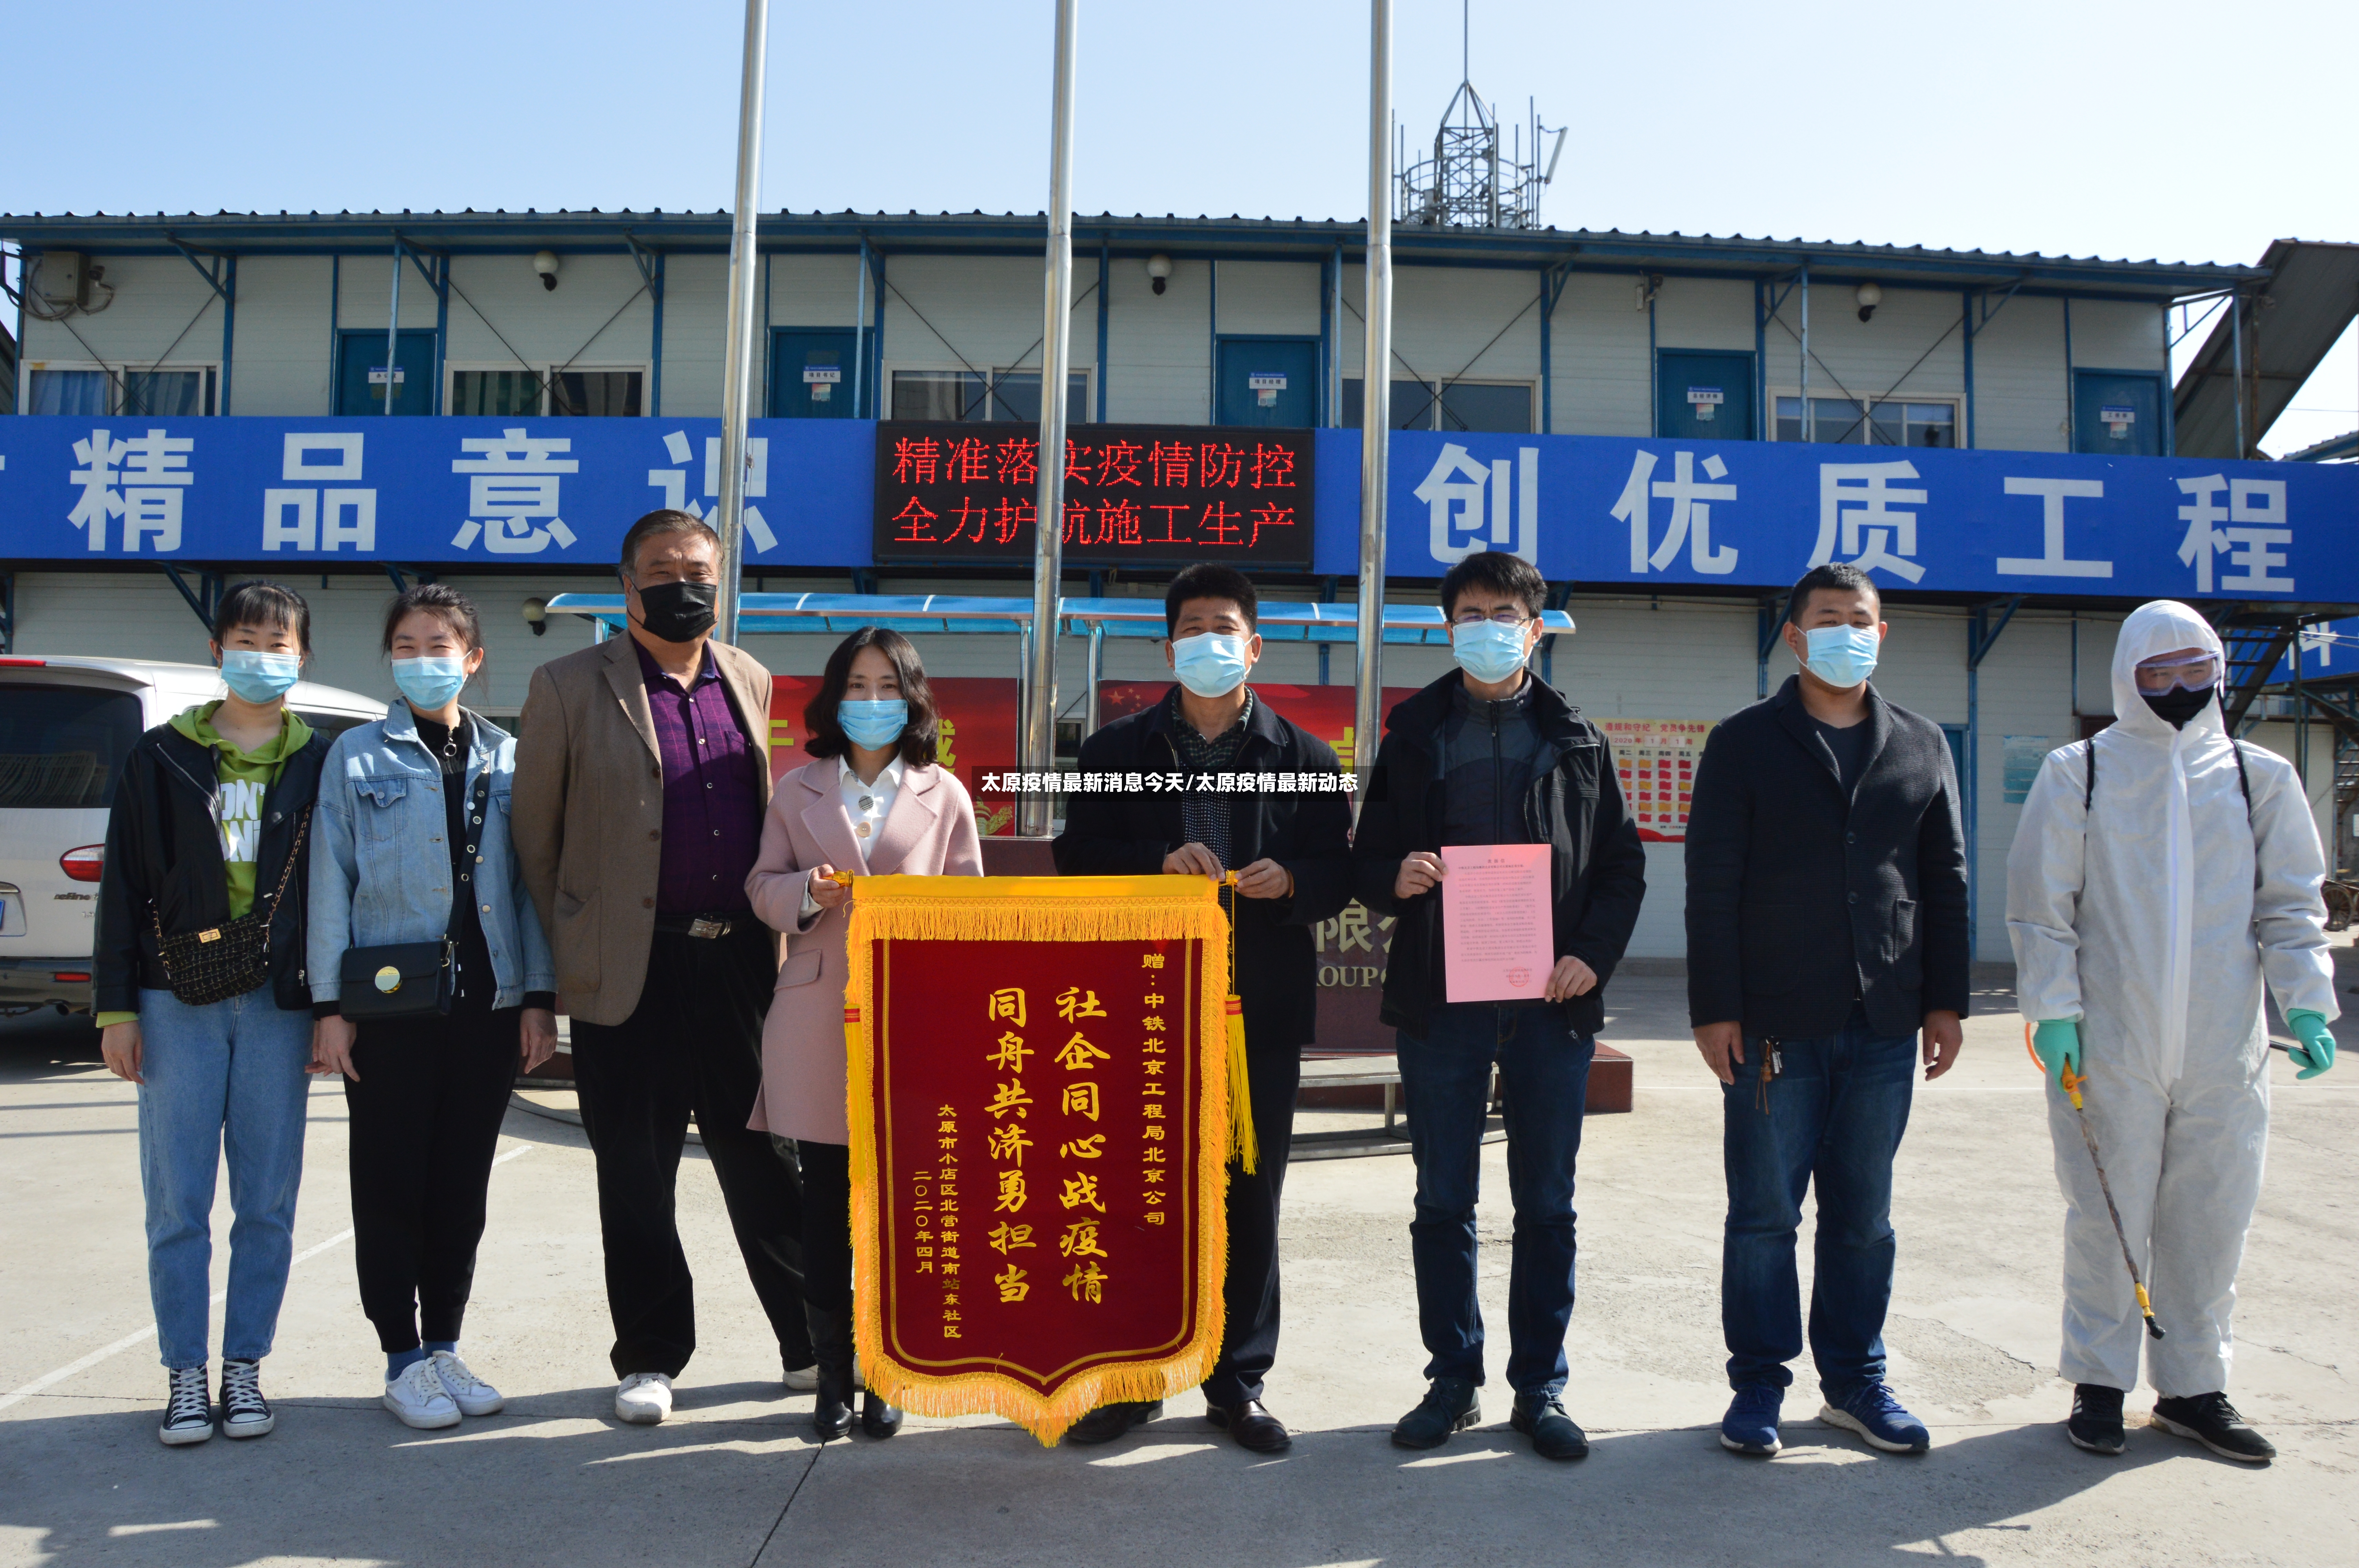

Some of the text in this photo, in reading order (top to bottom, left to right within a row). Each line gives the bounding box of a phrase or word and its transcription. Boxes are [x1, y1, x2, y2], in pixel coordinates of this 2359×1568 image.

[0, 428, 778, 554] 精品意识
[892, 496, 1294, 548] 全力护航施工生产
[893, 436, 1296, 488] 精准落实疫情防控
[1413, 443, 2294, 592] 创优质工程
[1316, 966, 1378, 987] OUP
[984, 987, 1037, 1303] 同舟共济勇担当
[1054, 987, 1111, 1304] 社企同心战疫情
[938, 1104, 962, 1338] 太原市小店区北营街道南站东社区
